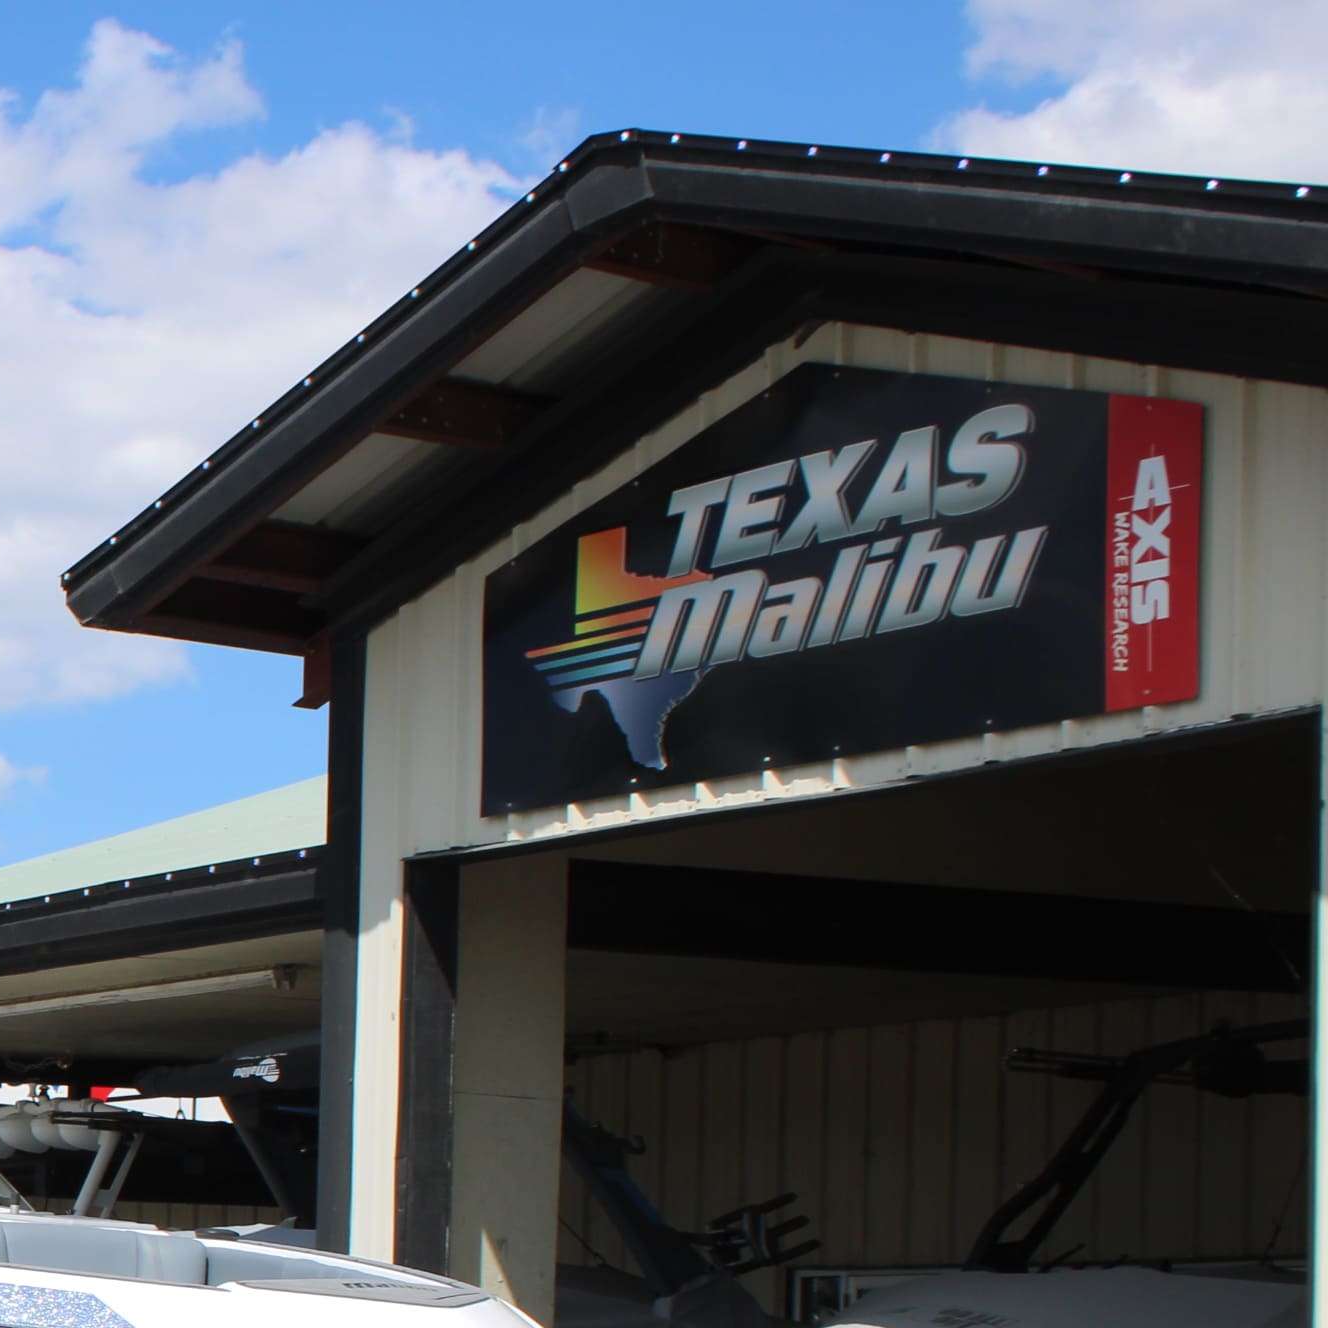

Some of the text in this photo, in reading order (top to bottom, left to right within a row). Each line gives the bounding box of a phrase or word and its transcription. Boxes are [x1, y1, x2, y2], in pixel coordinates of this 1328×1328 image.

[667, 402, 1035, 577] TEXAS
[1129, 454, 1173, 625] AXIS
[632, 524, 1050, 681] Malibu
[1112, 511, 1131, 674] WAKE RESEARCH
